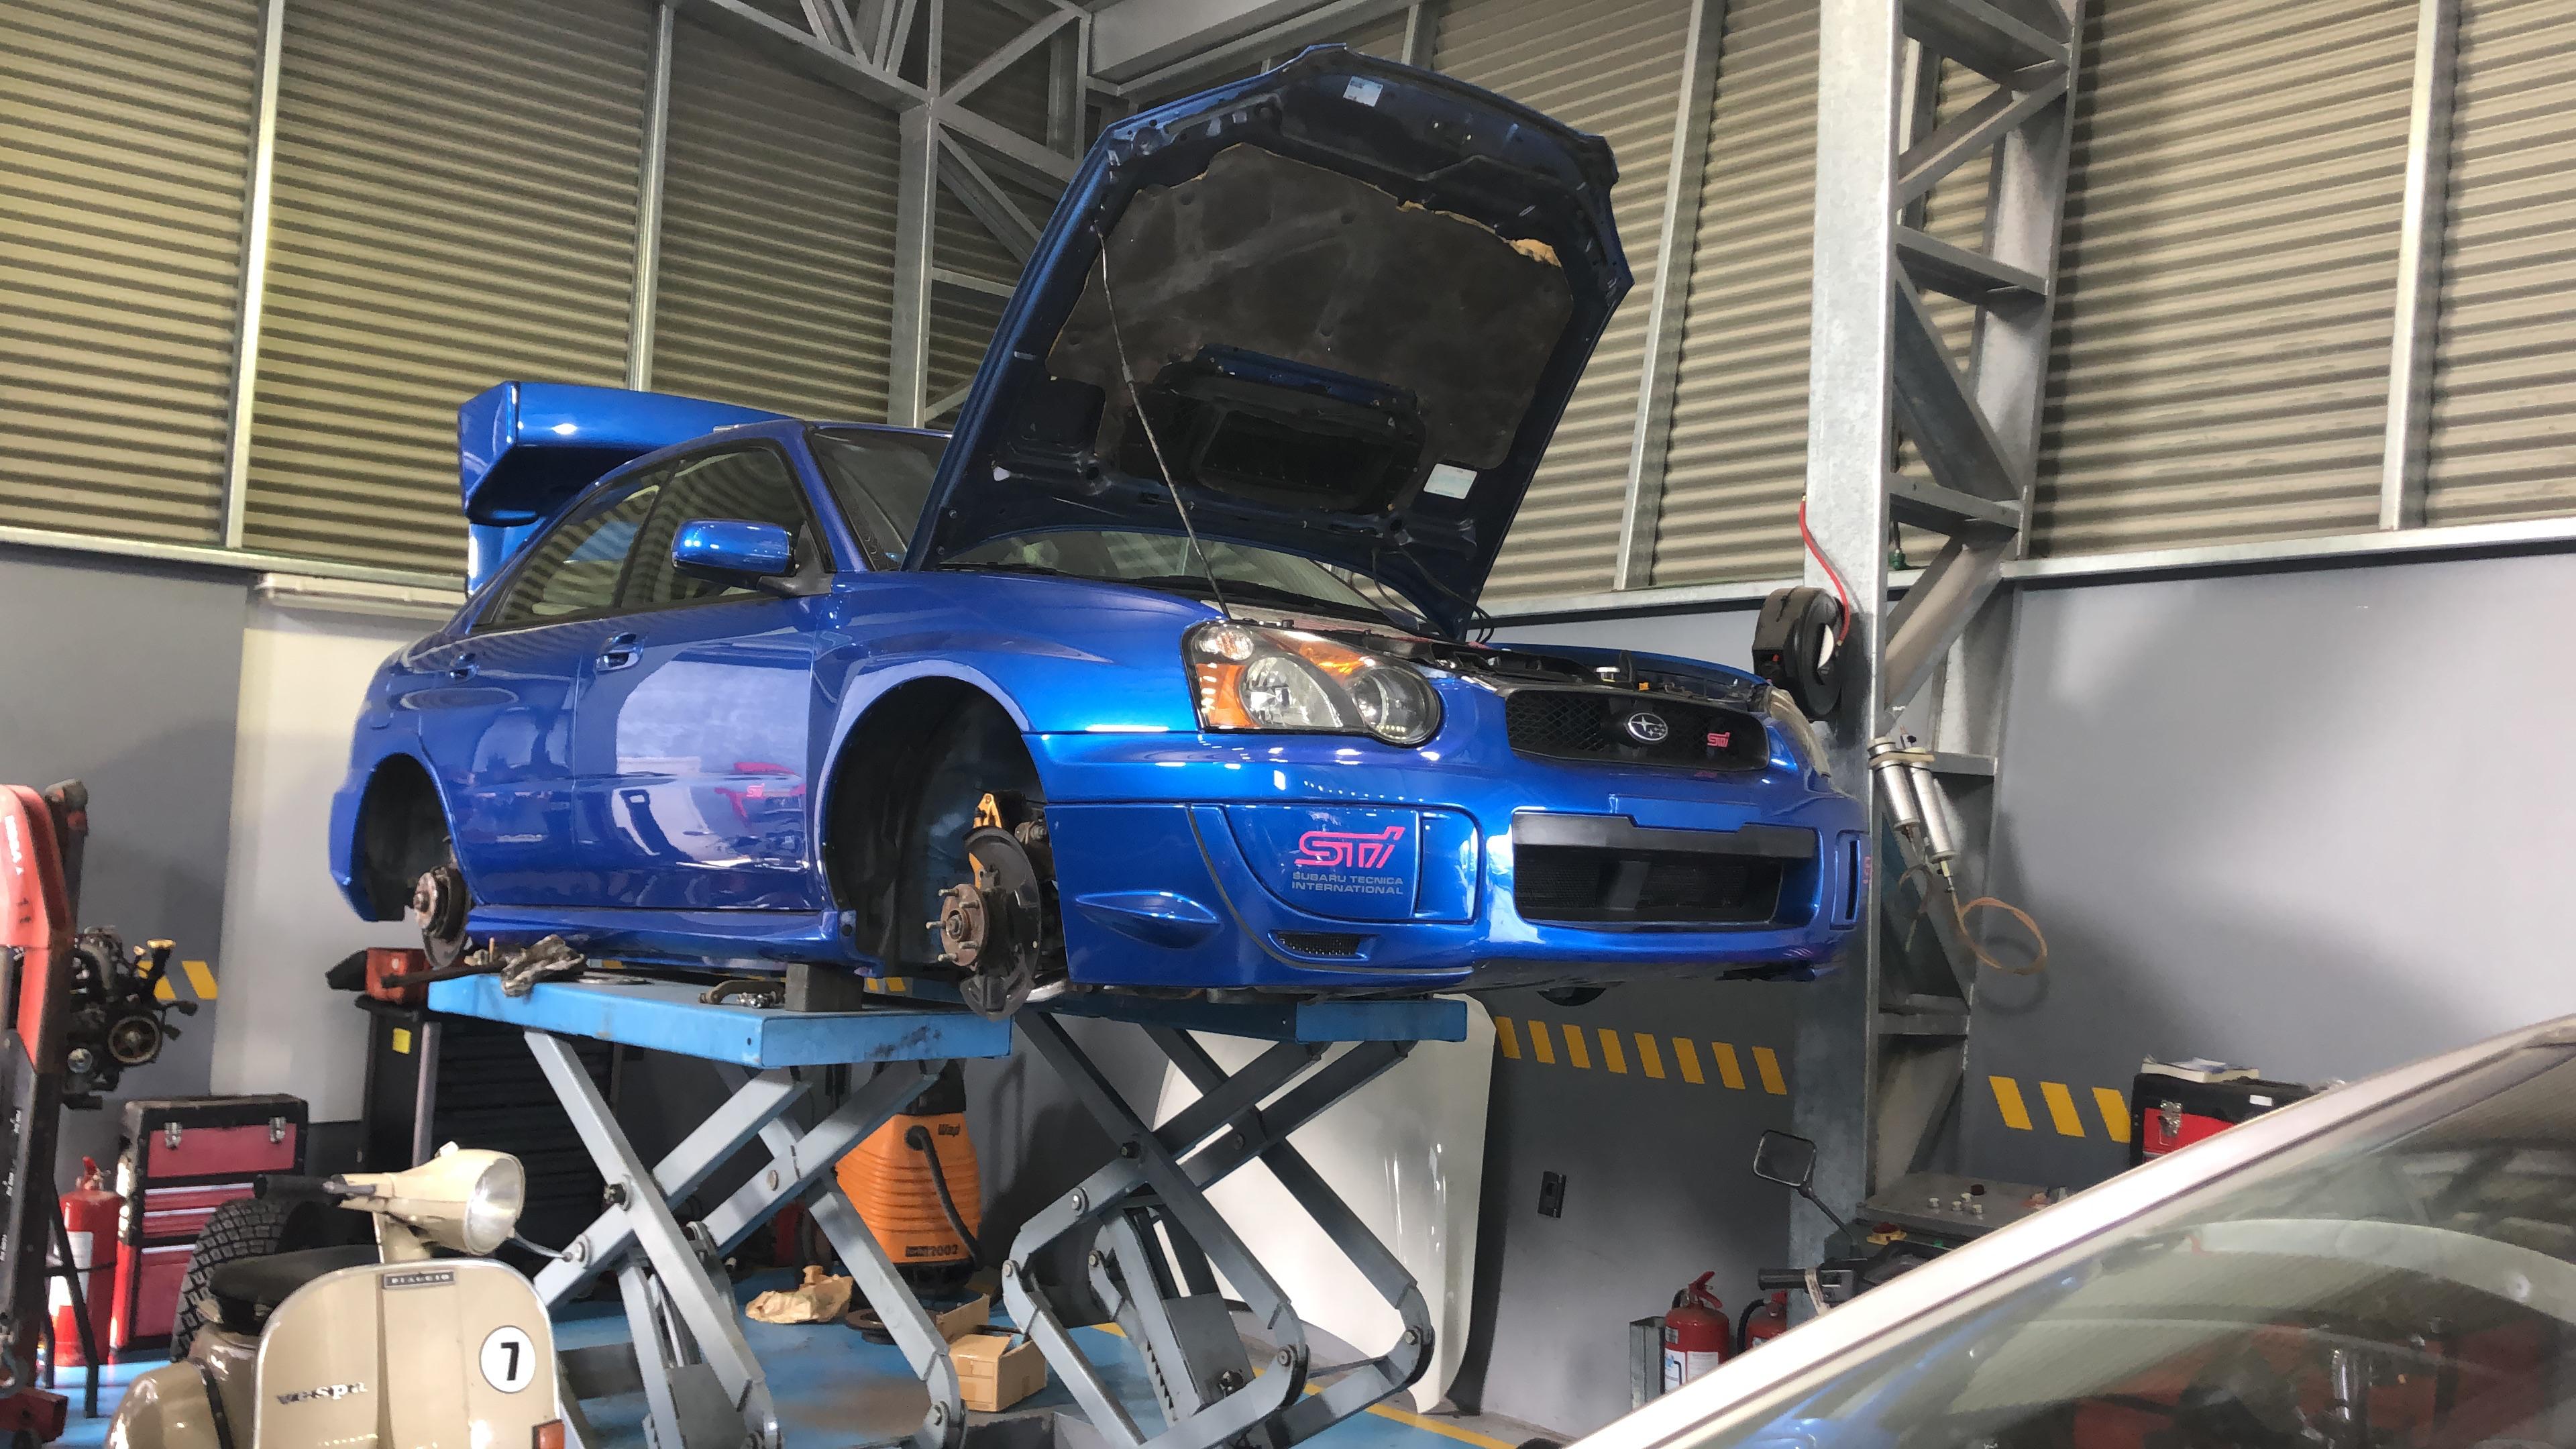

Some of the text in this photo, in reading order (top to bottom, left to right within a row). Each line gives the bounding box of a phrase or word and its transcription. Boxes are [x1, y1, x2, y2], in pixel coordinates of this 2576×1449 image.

[1293, 871, 1403, 885] SUBARU TECNICA
[1291, 881, 1403, 895] INTERNATIONAL
[500, 1342, 520, 1381] 7
